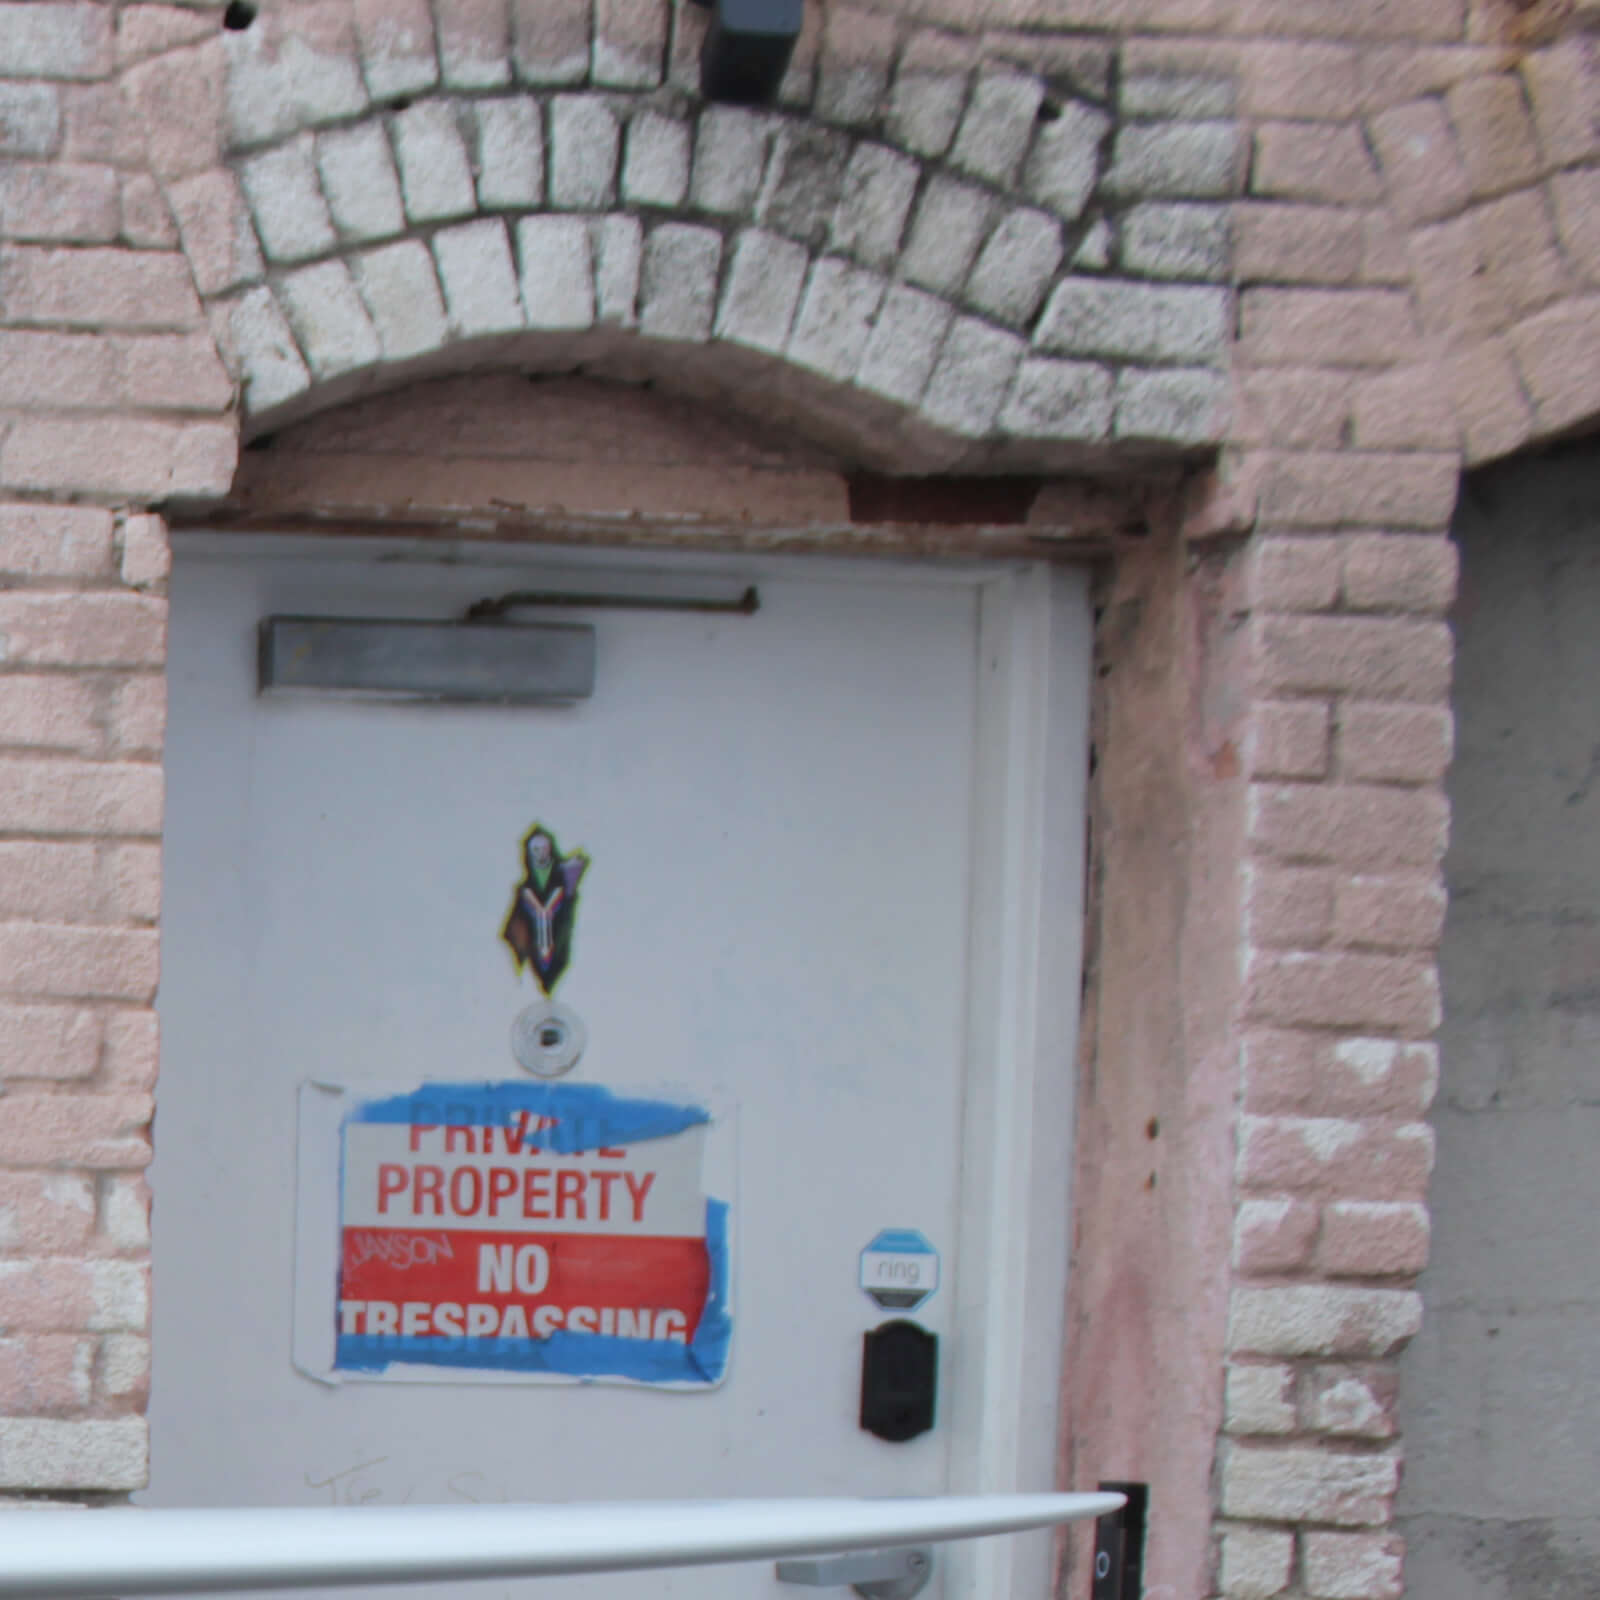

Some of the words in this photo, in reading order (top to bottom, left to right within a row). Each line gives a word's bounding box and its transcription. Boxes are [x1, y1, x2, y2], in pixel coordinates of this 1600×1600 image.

[376, 1162, 656, 1222] PROPERTY
[476, 1243, 550, 1295] NO
[877, 1256, 920, 1285] ring
